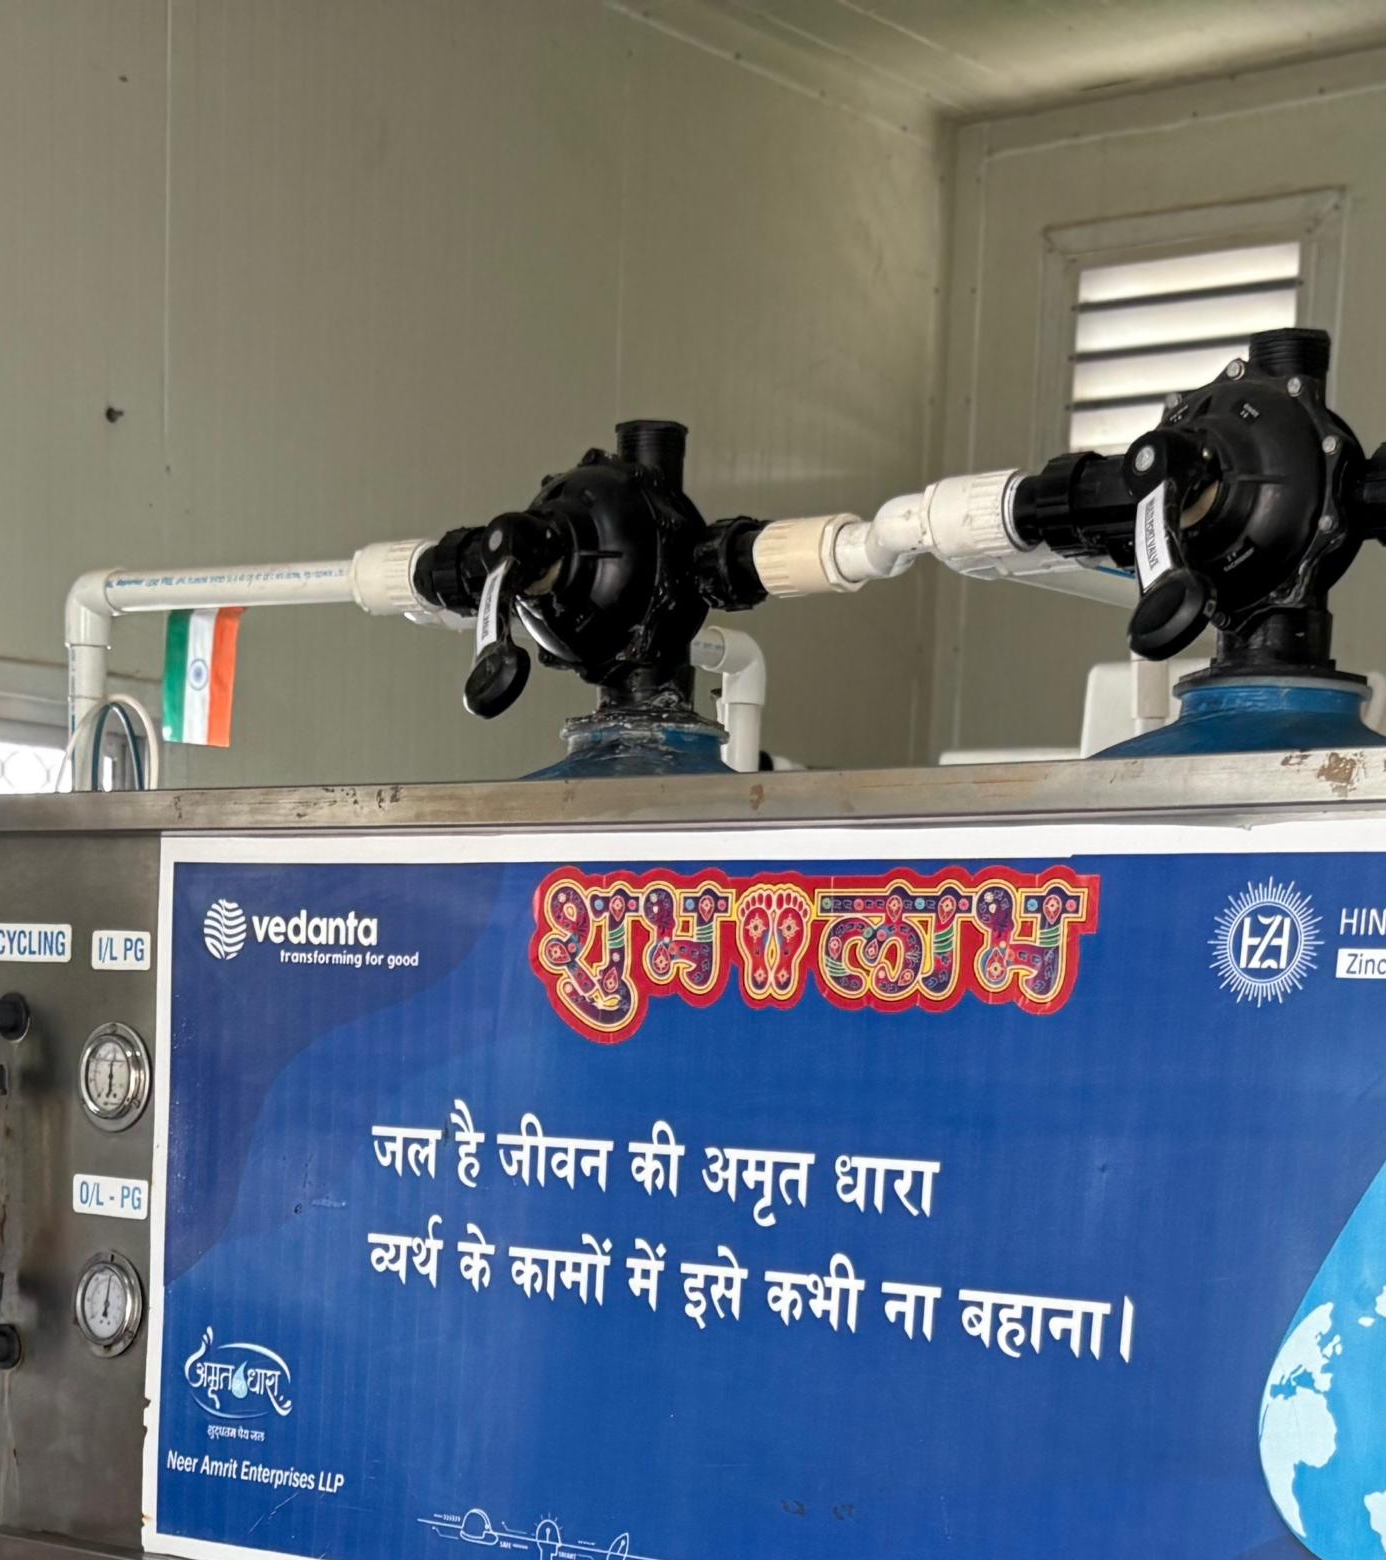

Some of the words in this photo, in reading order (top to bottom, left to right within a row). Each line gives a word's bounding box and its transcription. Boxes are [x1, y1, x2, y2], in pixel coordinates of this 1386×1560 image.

[252, 909, 378, 946] vedanta
[98, 937, 119, 963] I/L
[124, 937, 145, 963] PG
[280, 949, 363, 968] transforming
[365, 951, 383, 966] for
[387, 951, 419, 969] good
[538, 872, 733, 1032] शुभ
[813, 876, 1091, 1006] लाभ
[1346, 953, 1386, 976] Zinc
[372, 1124, 442, 1182] जल
[449, 1099, 485, 1190] है
[497, 1112, 615, 1197] जीवन
[628, 1119, 685, 1200] की
[702, 1144, 815, 1229] अमृत
[835, 1154, 941, 1218] धारा
[79, 1183, 104, 1208] O/L
[120, 1185, 142, 1210] PG
[368, 1215, 442, 1289] व्यर्थ
[458, 1229, 495, 1292] के
[509, 1234, 612, 1309] कामों
[626, 1240, 666, 1312] में
[681, 1246, 748, 1329] इसे
[767, 1254, 864, 1334] कभी
[882, 1282, 942, 1342] ना
[167, 1450, 198, 1472] Neer
[200, 1455, 237, 1479] Amrit
[241, 1461, 315, 1489] Enterprises
[318, 1471, 345, 1493] LLP
